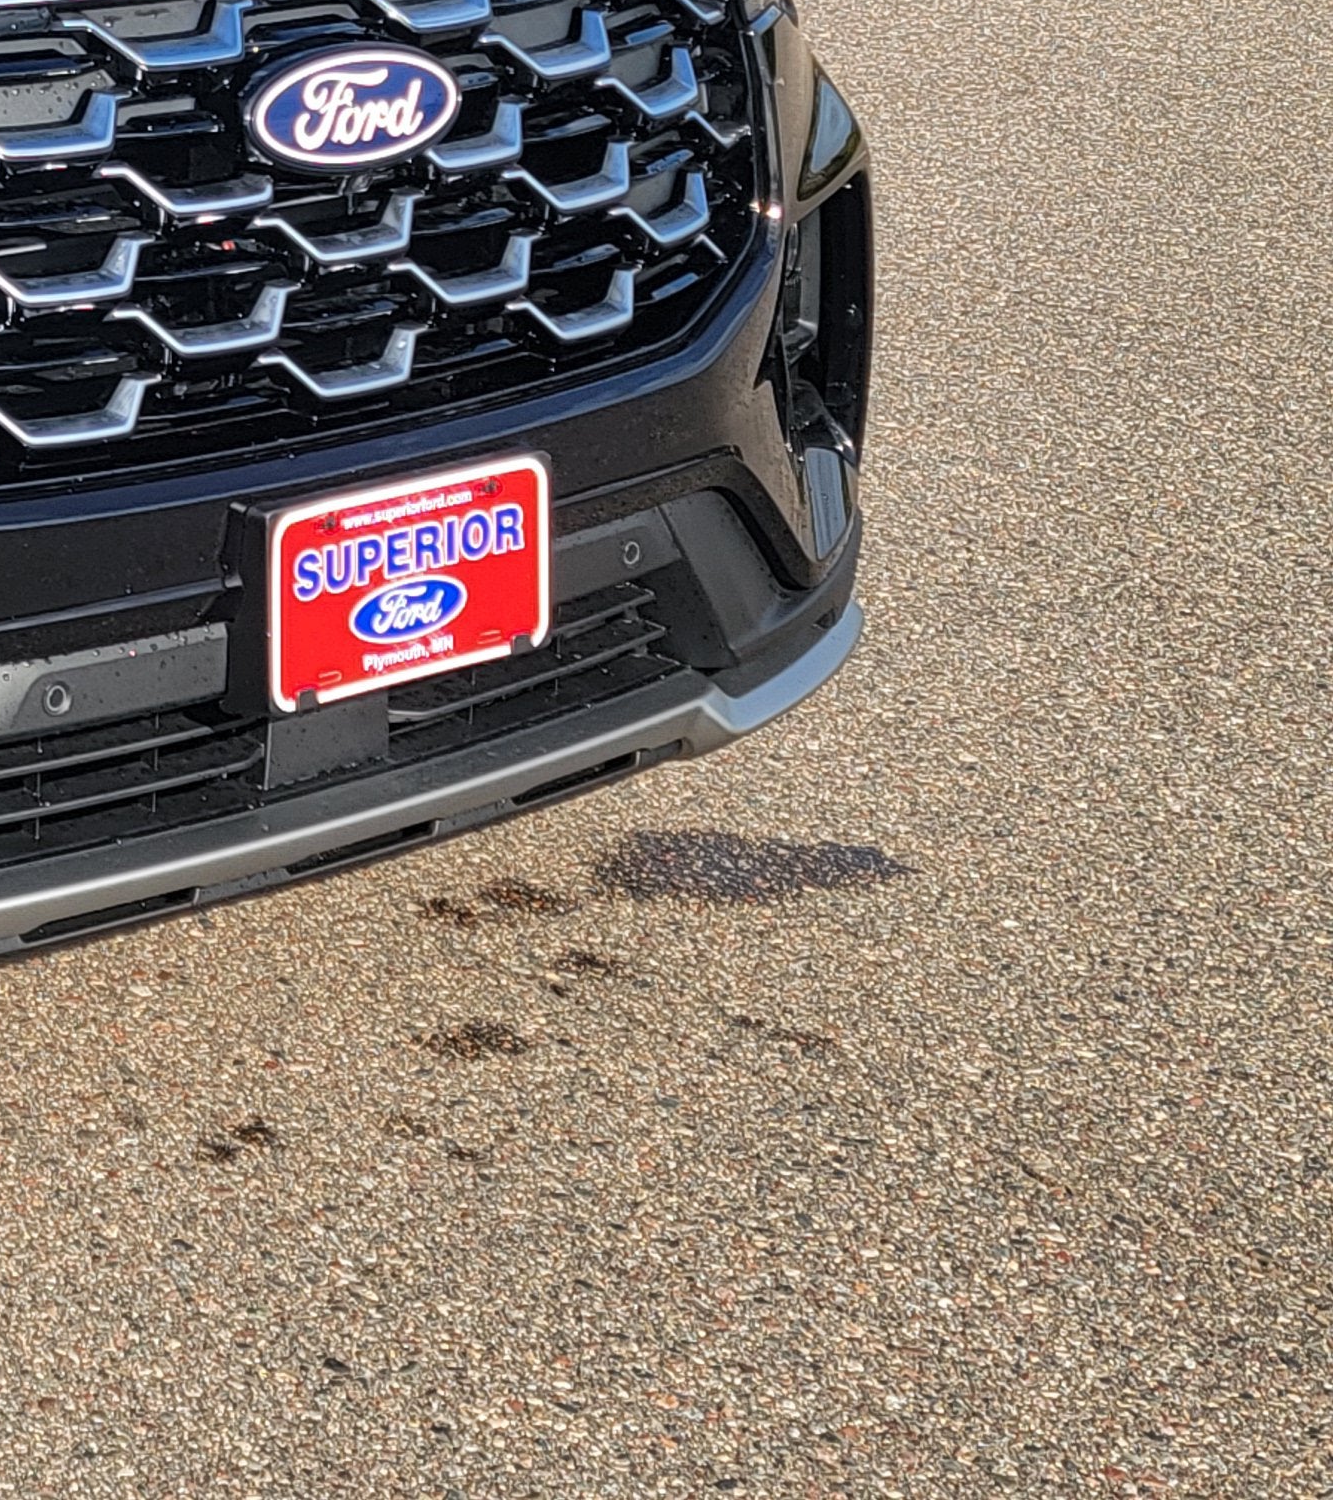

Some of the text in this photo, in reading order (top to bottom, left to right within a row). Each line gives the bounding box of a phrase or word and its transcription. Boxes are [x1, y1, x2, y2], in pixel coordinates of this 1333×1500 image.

[293, 67, 424, 150] Ford
[293, 503, 526, 602] SUPERIOR
[371, 583, 445, 634] Ford
[362, 643, 429, 672] Plymouth,
